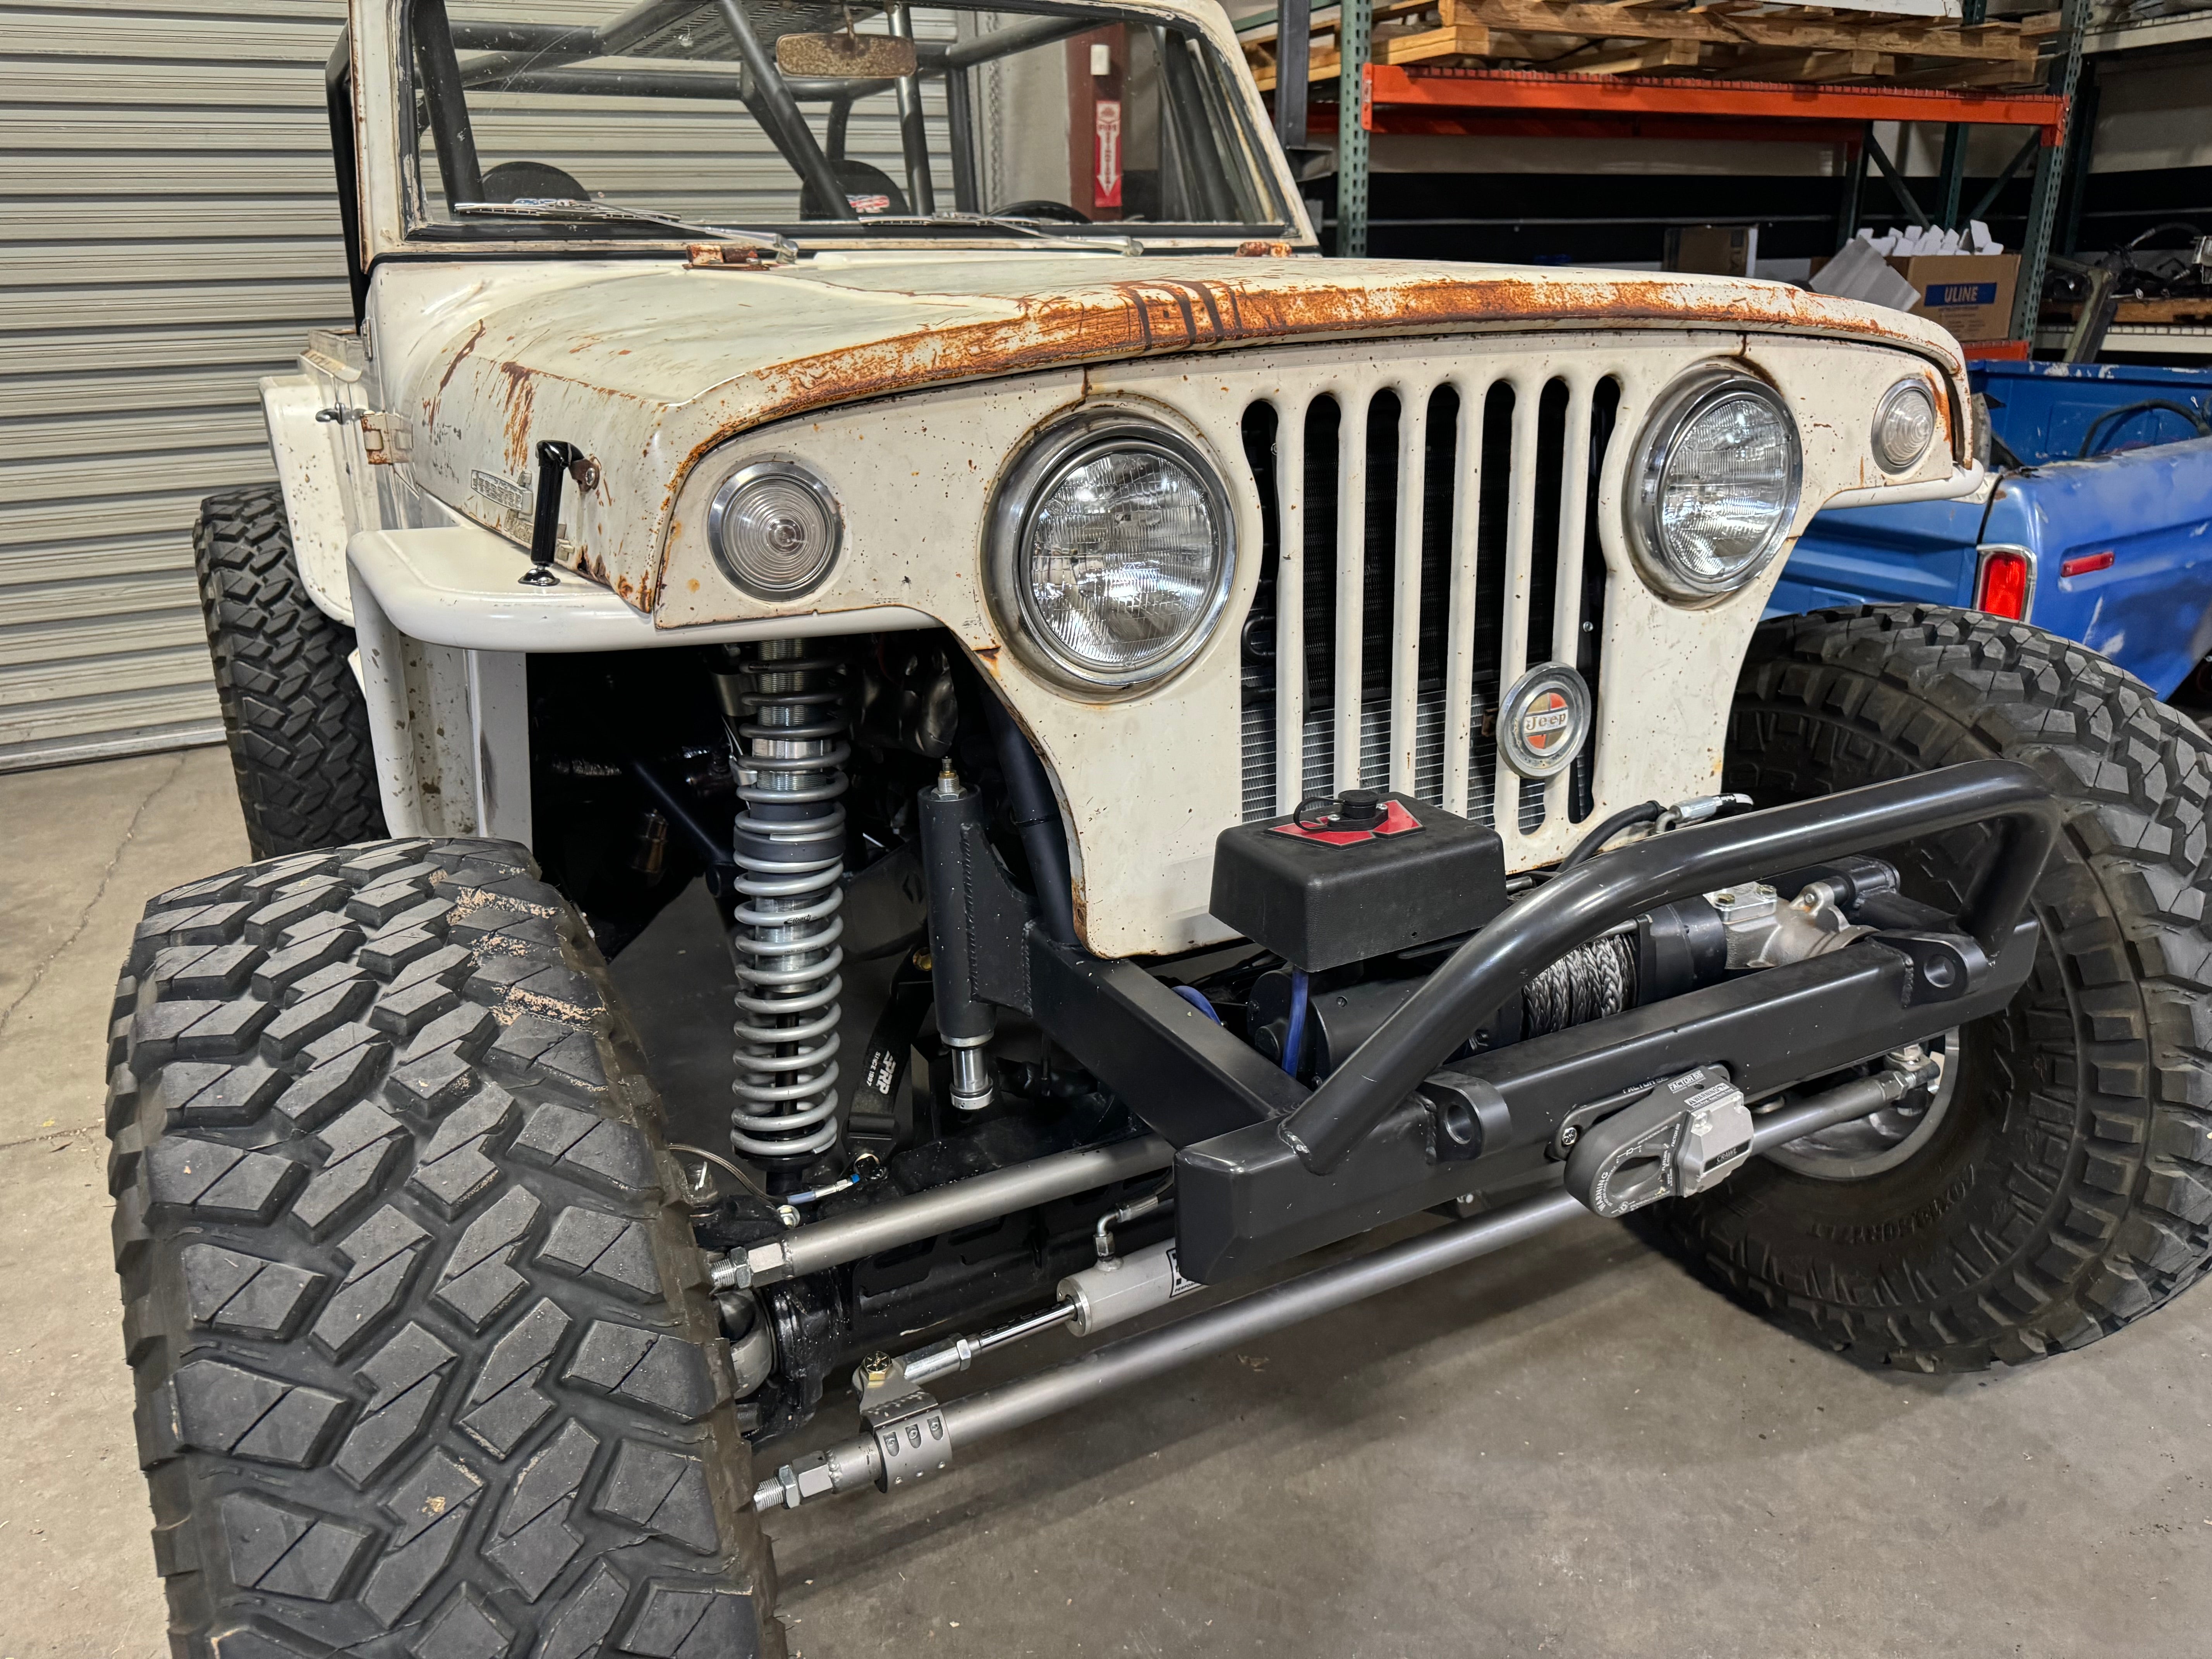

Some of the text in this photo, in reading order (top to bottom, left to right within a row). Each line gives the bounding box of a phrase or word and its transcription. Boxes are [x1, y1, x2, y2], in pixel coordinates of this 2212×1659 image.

[1945, 286, 1978, 302] ULINE
[1526, 713, 1566, 730] Jeep
[866, 1051, 881, 1087] SINCE 1997
[876, 1050, 896, 1094] PRP
[1668, 1074, 1694, 1091] FACTOR
[1693, 1087, 1719, 1101] WARNING
[1595, 1171, 1608, 1212] WARNING
